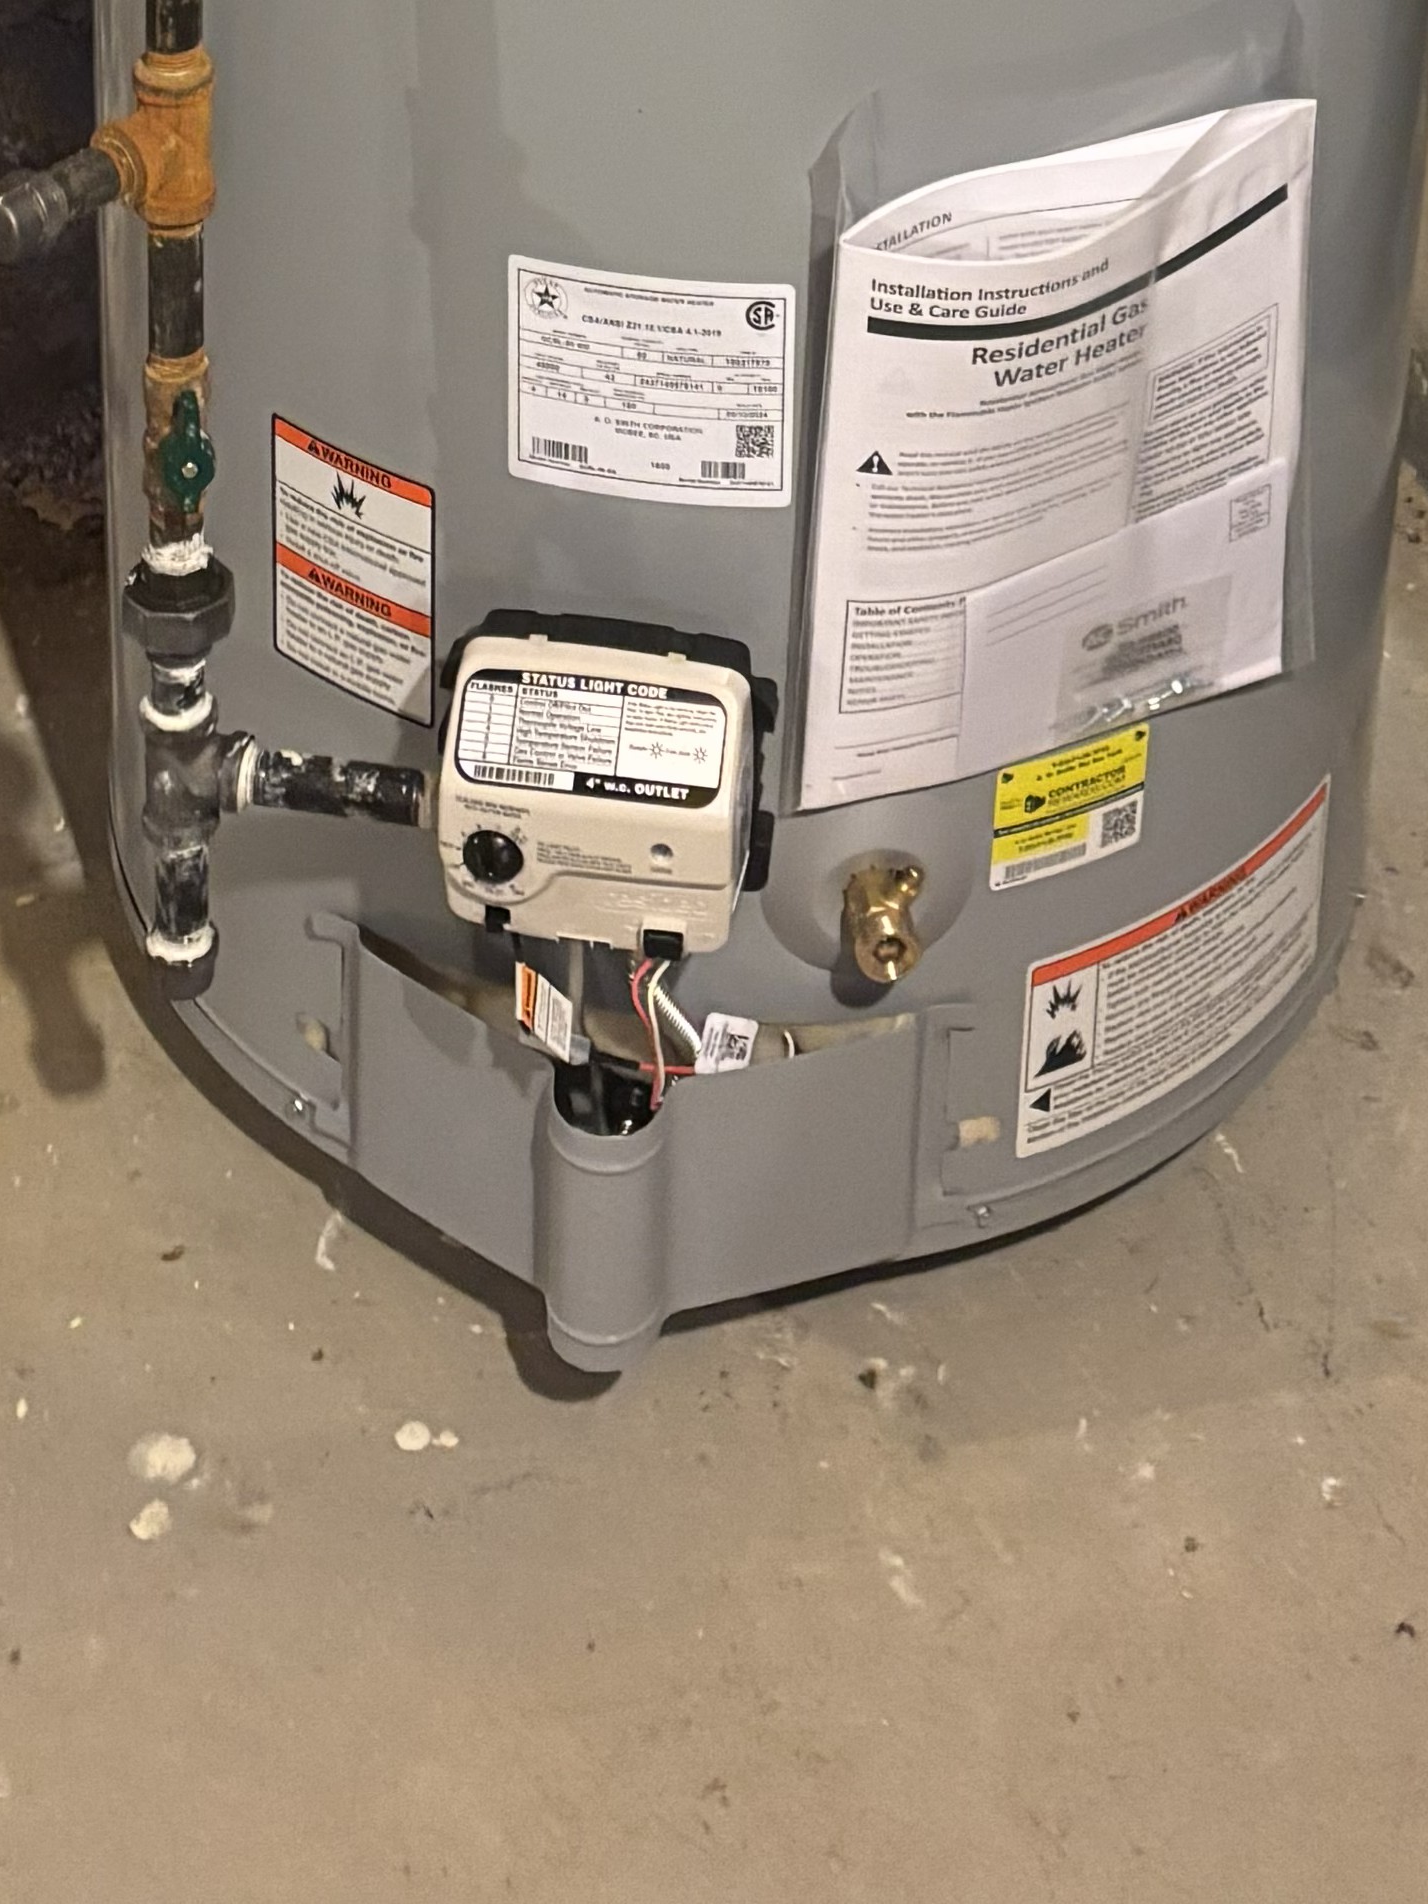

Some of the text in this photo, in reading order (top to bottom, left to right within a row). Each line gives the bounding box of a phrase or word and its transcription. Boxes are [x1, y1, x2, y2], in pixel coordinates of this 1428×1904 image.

[872, 257, 1110, 302] Installation Instructions and
[870, 296, 1027, 318] Use & Care Guide
[972, 297, 1150, 365] Residential Gas
[994, 354, 1068, 388] Water
[1074, 323, 1149, 366] Heater
[322, 449, 392, 489] WARNING
[322, 575, 392, 617] WARNING
[854, 605, 885, 617] Table
[889, 605, 902, 616] of
[522, 671, 668, 700] STATUS LIGHT CODE
[522, 688, 559, 698] STATUS
[634, 783, 689, 800] OUTLET
